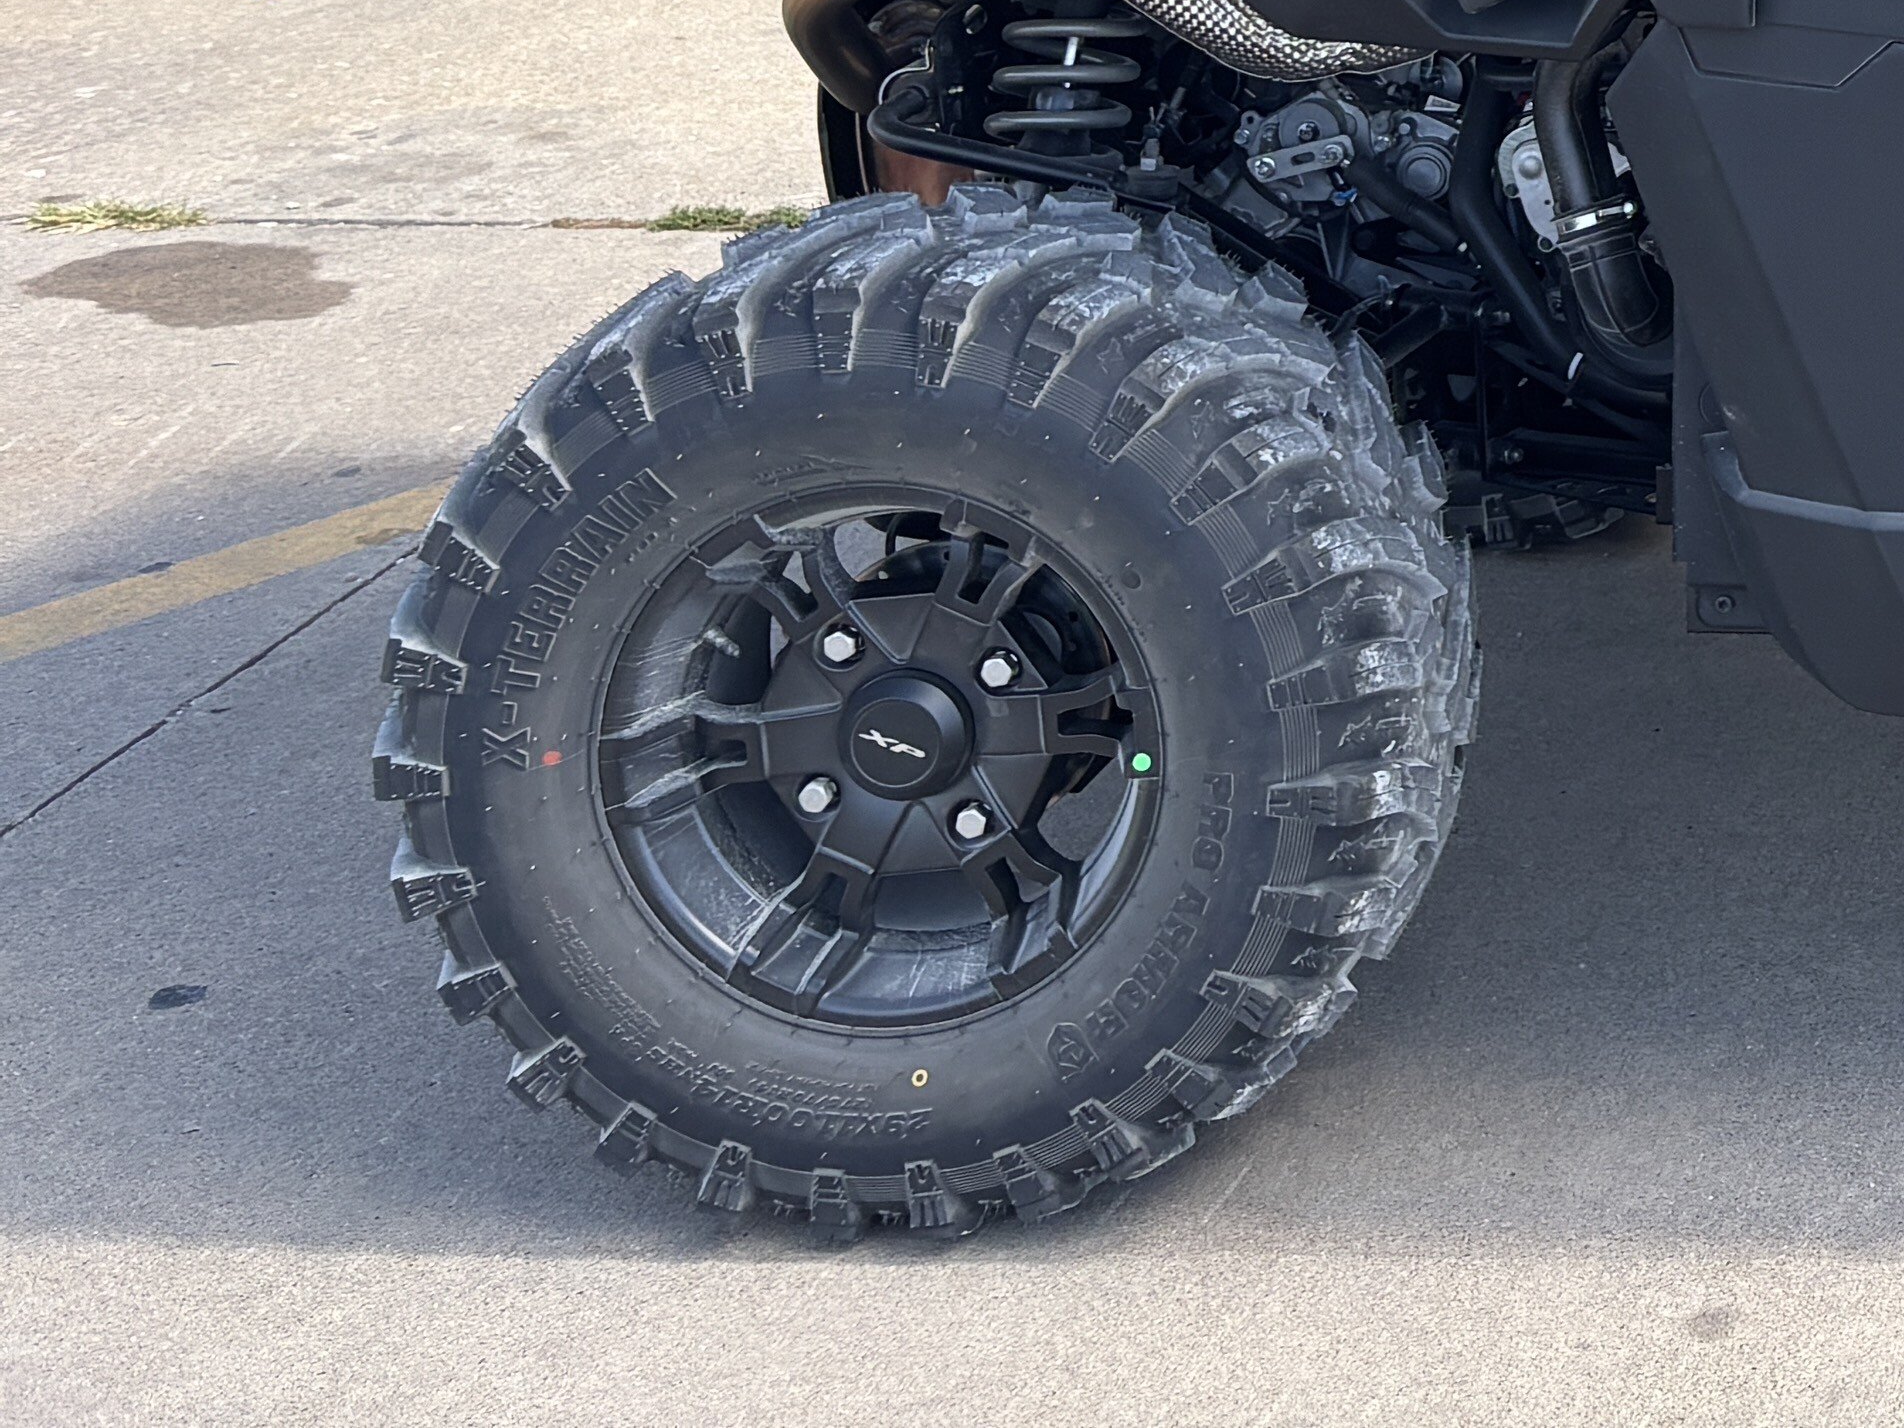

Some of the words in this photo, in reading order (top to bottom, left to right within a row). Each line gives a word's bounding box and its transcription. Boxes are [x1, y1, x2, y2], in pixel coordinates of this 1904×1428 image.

[479, 467, 678, 771] X-TERRAIN
[858, 728, 926, 758] XP
[1190, 770, 1235, 874] PRO
[1084, 881, 1212, 1042] ARMOR
